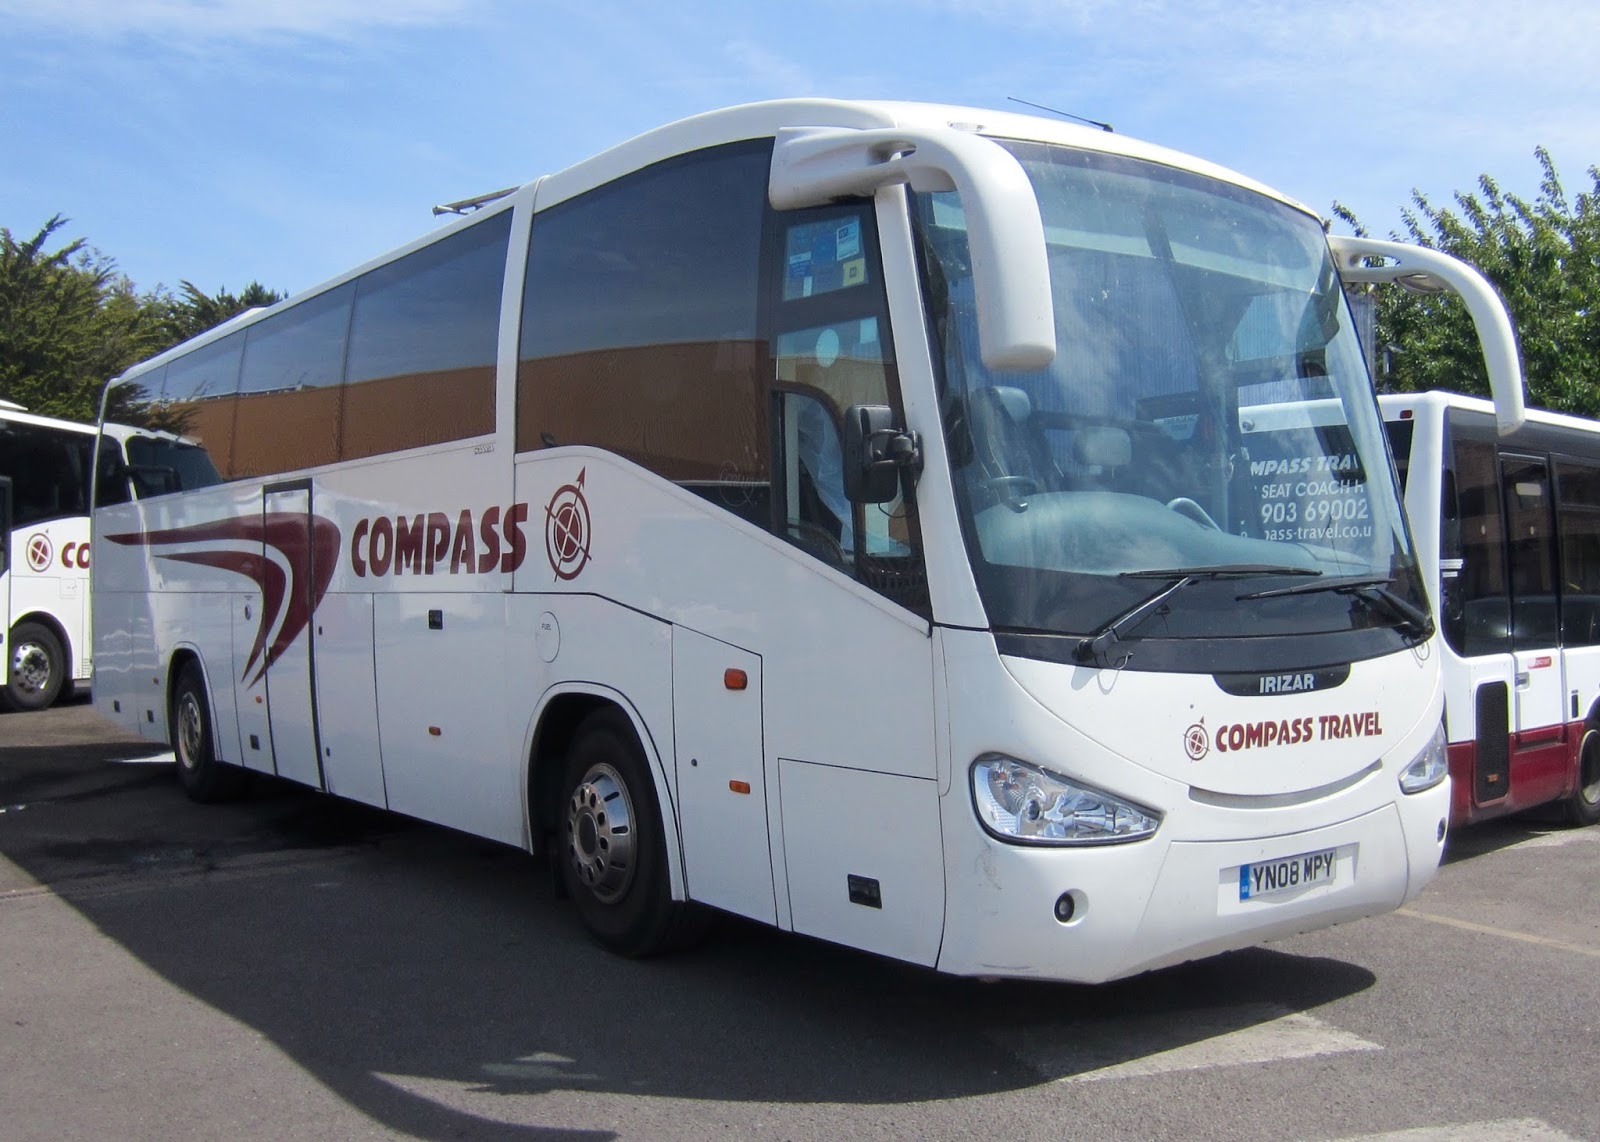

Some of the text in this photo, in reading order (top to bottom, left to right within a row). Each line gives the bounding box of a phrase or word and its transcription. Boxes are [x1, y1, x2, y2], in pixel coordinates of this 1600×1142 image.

[1262, 483, 1292, 499] SEAT
[1295, 478, 1350, 497] COACH
[1261, 498, 1369, 523] 903 69002
[351, 503, 528, 578] COMPASS
[1259, 673, 1315, 693] IRIZAR
[1215, 711, 1383, 753] COMPASS TRAVEL
[1253, 852, 1333, 892] YN08 MPY
